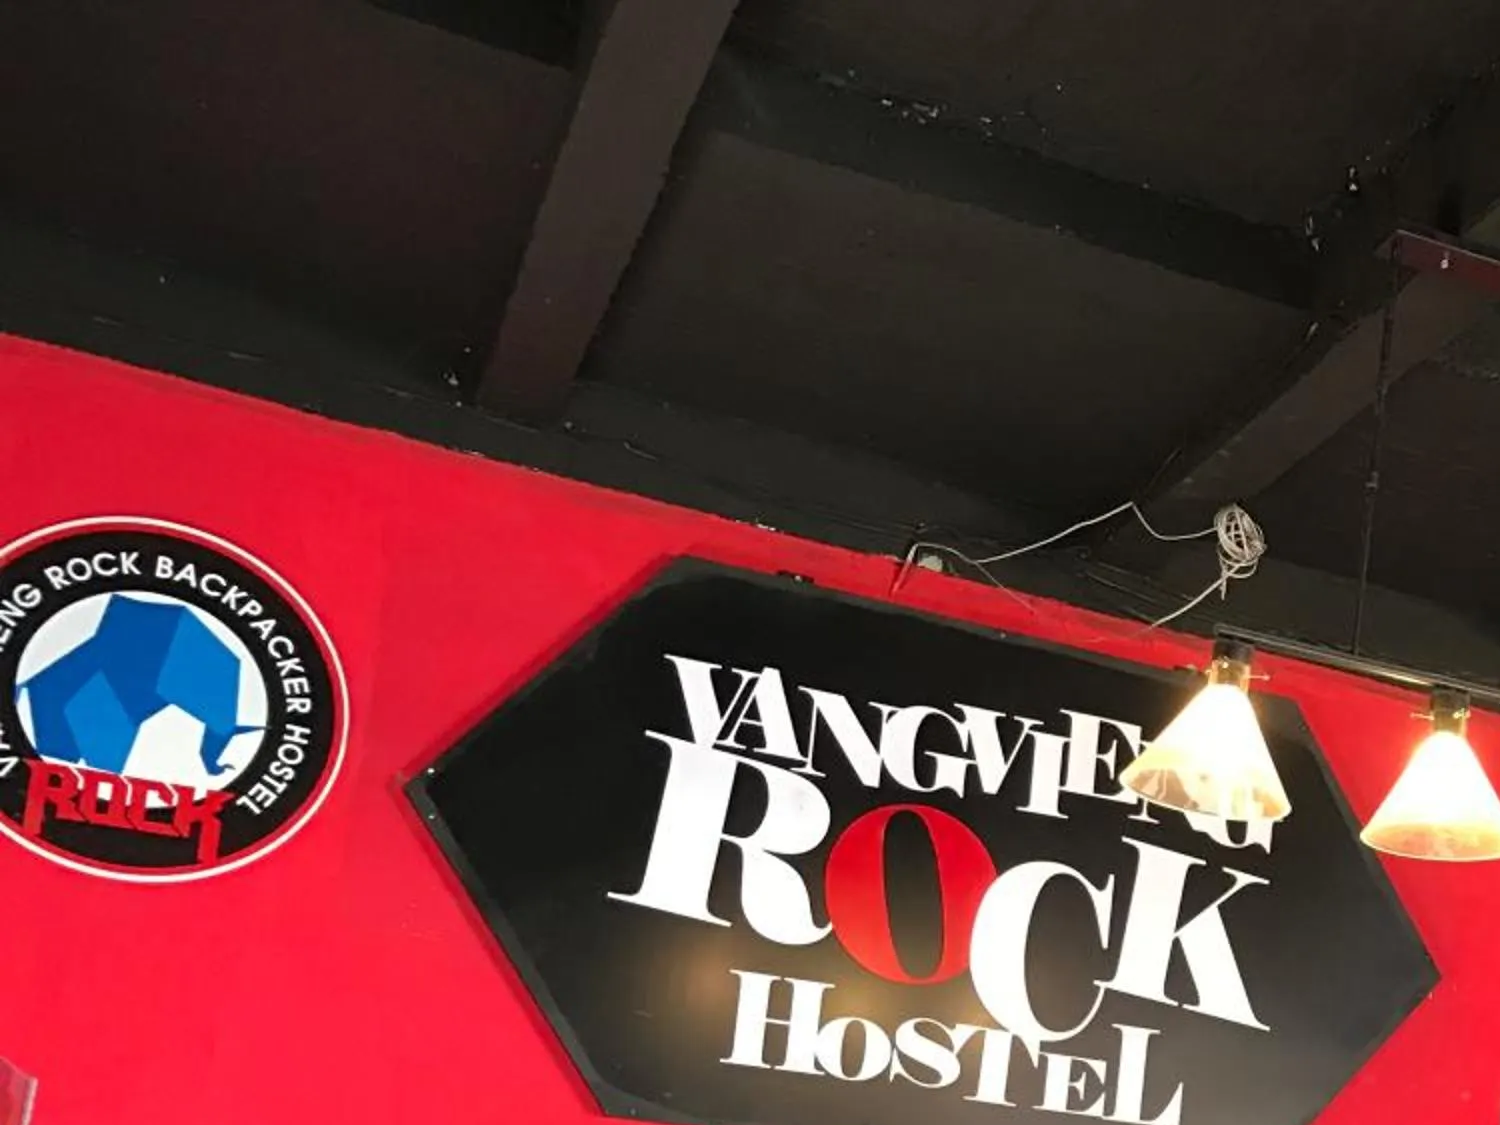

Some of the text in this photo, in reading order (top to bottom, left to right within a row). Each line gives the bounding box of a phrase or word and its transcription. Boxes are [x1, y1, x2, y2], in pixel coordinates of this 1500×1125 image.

[21, 758, 236, 865] ROCK
[44, 551, 141, 590] ROCK
[155, 555, 312, 715] BACKPACKER
[236, 724, 312, 814] HOSTEL
[608, 730, 1270, 1042] ROCK
